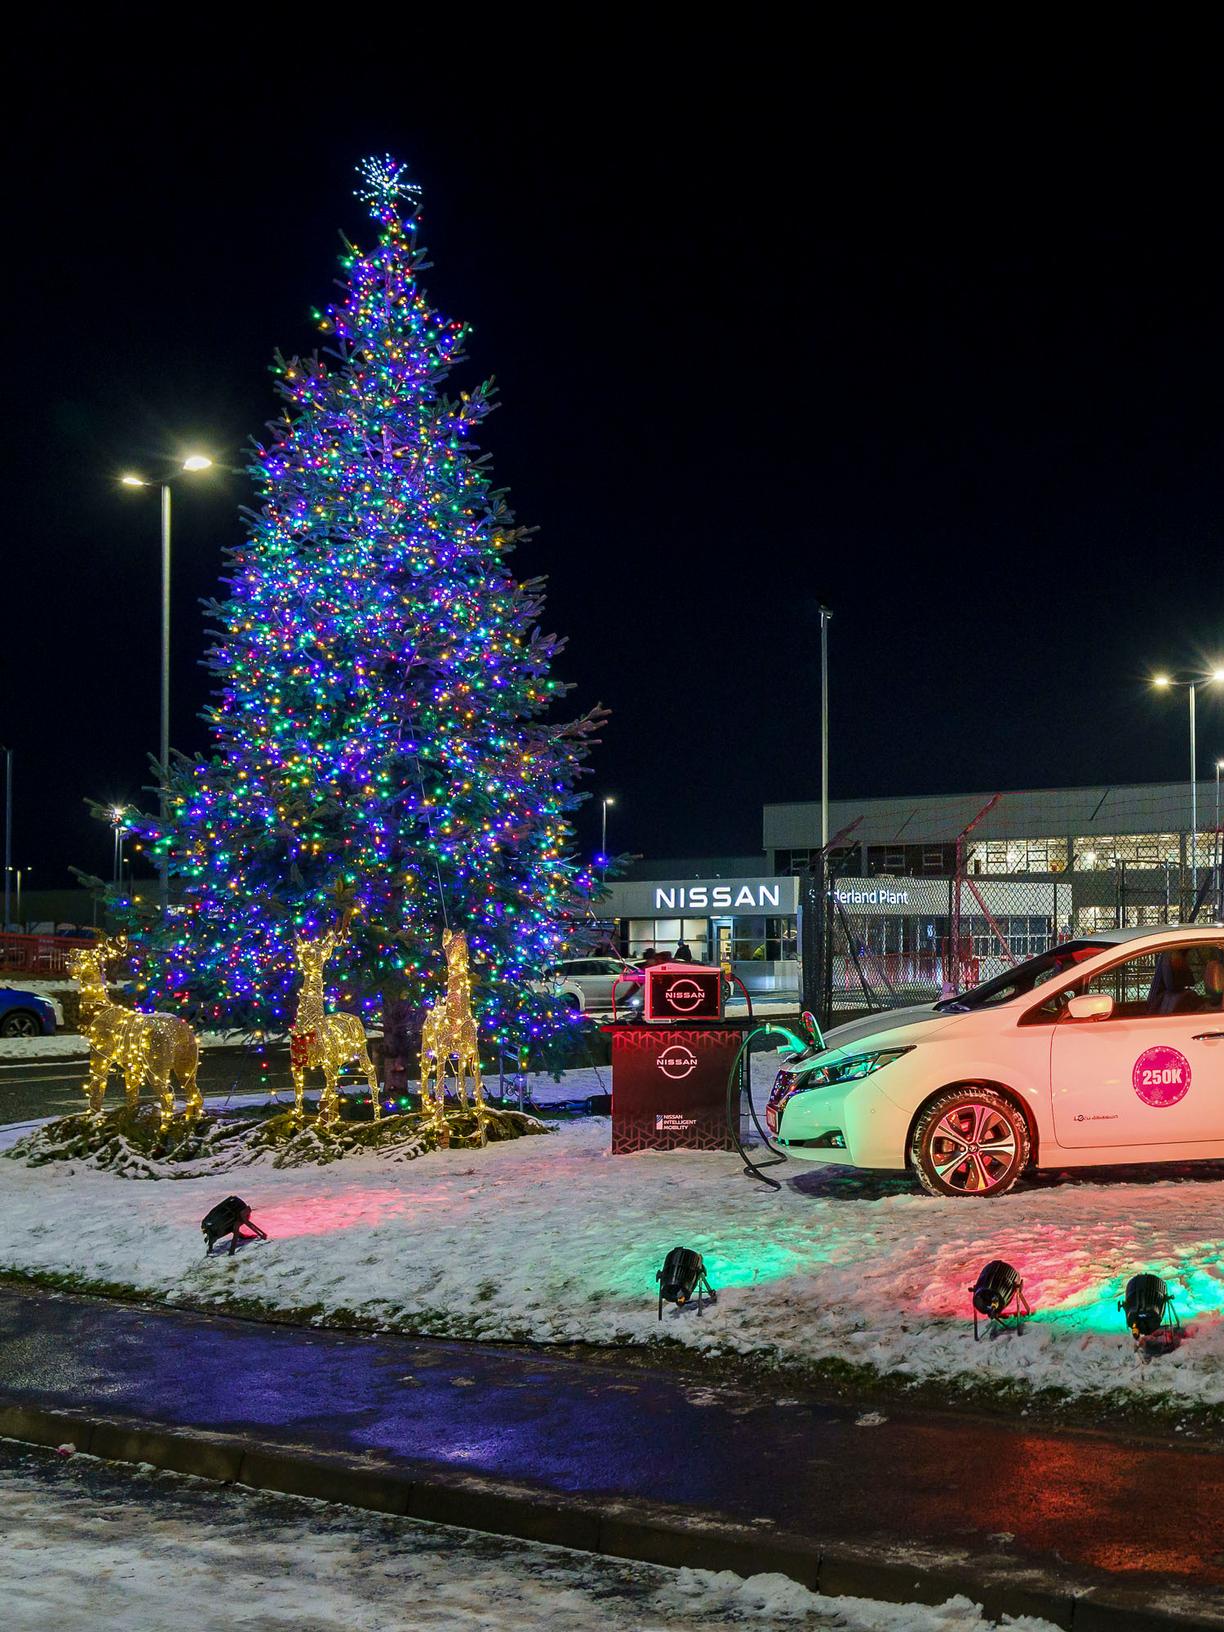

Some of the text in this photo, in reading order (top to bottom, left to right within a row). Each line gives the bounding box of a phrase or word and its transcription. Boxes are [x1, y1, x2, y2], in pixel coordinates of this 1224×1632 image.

[656, 885, 780, 909] NISSAN
[880, 889, 909, 904] Plant
[1142, 1068, 1183, 1085] 250K
